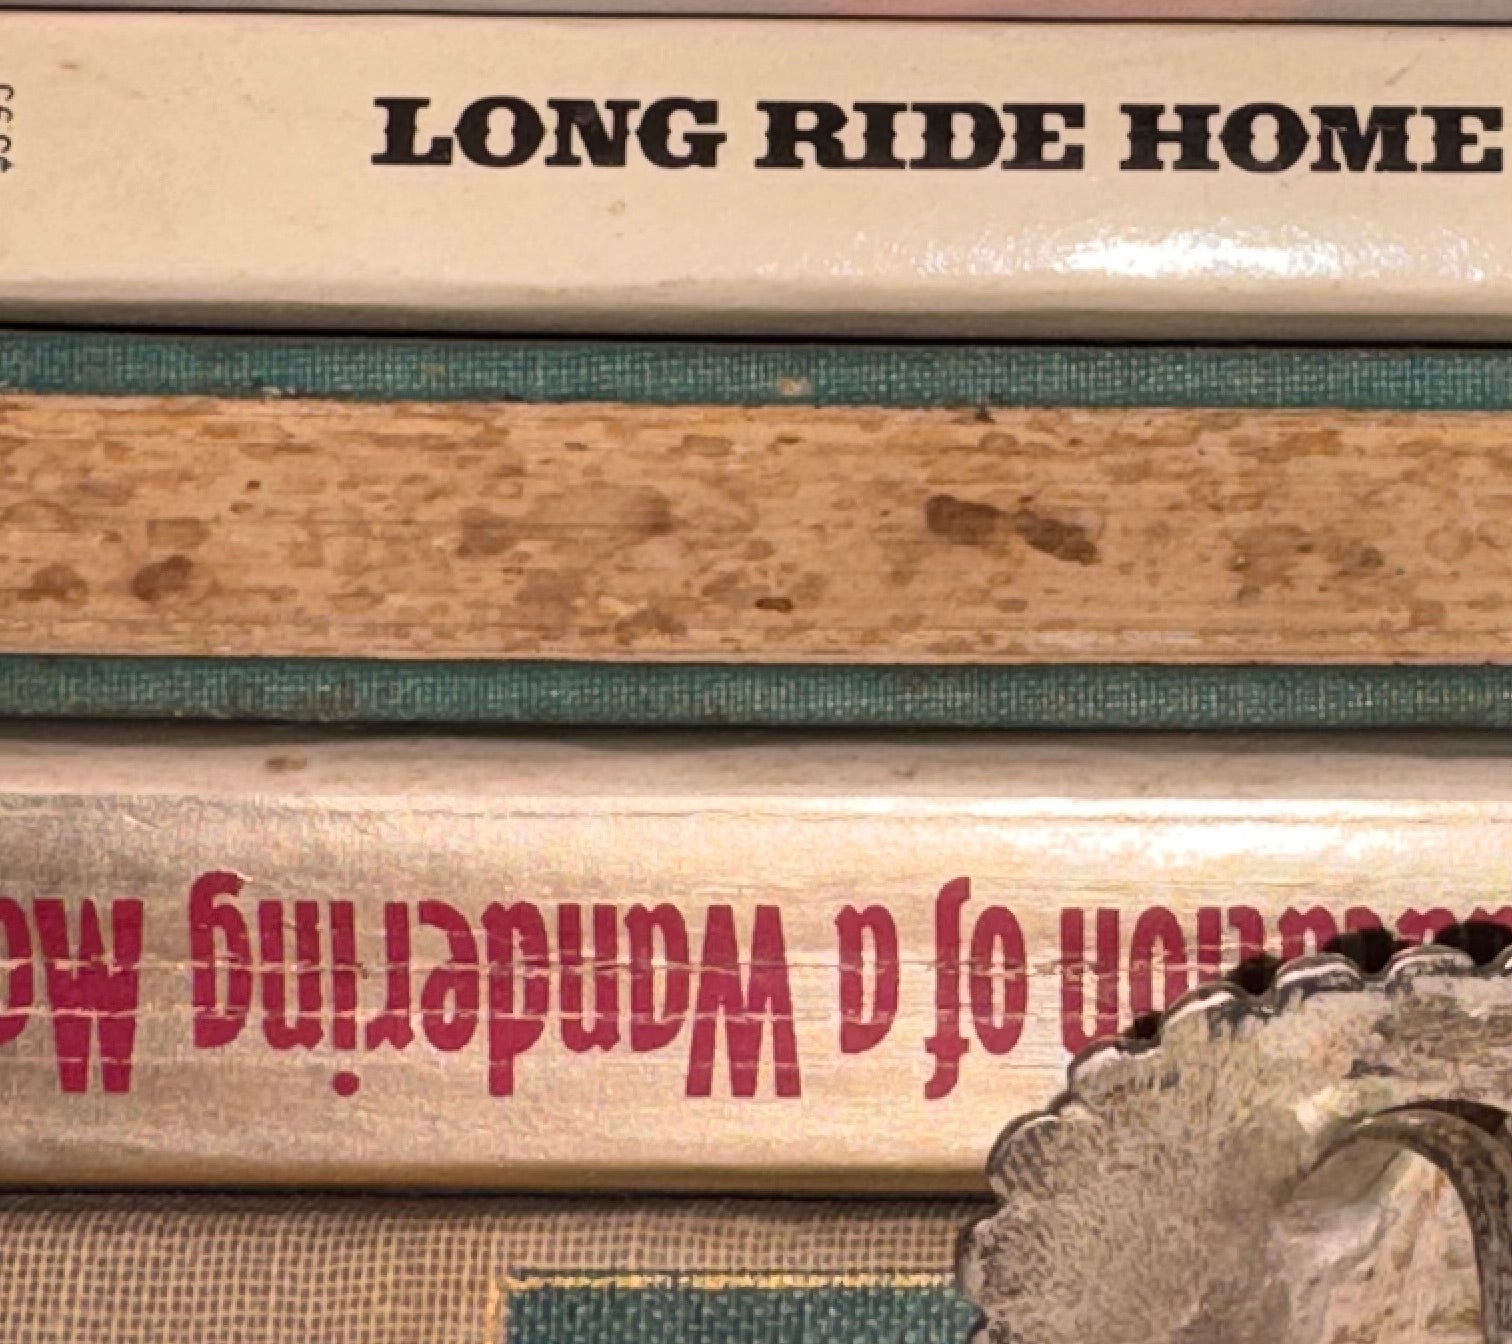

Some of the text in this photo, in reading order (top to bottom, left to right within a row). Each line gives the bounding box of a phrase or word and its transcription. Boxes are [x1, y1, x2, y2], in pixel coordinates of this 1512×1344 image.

[371, 96, 727, 168] LONG
[755, 100, 1085, 170] RIDE
[1120, 102, 1503, 173] HOME
[190, 871, 801, 1099] Wandering
[835, 904, 898, 1054] a
[924, 877, 1029, 1100] of
